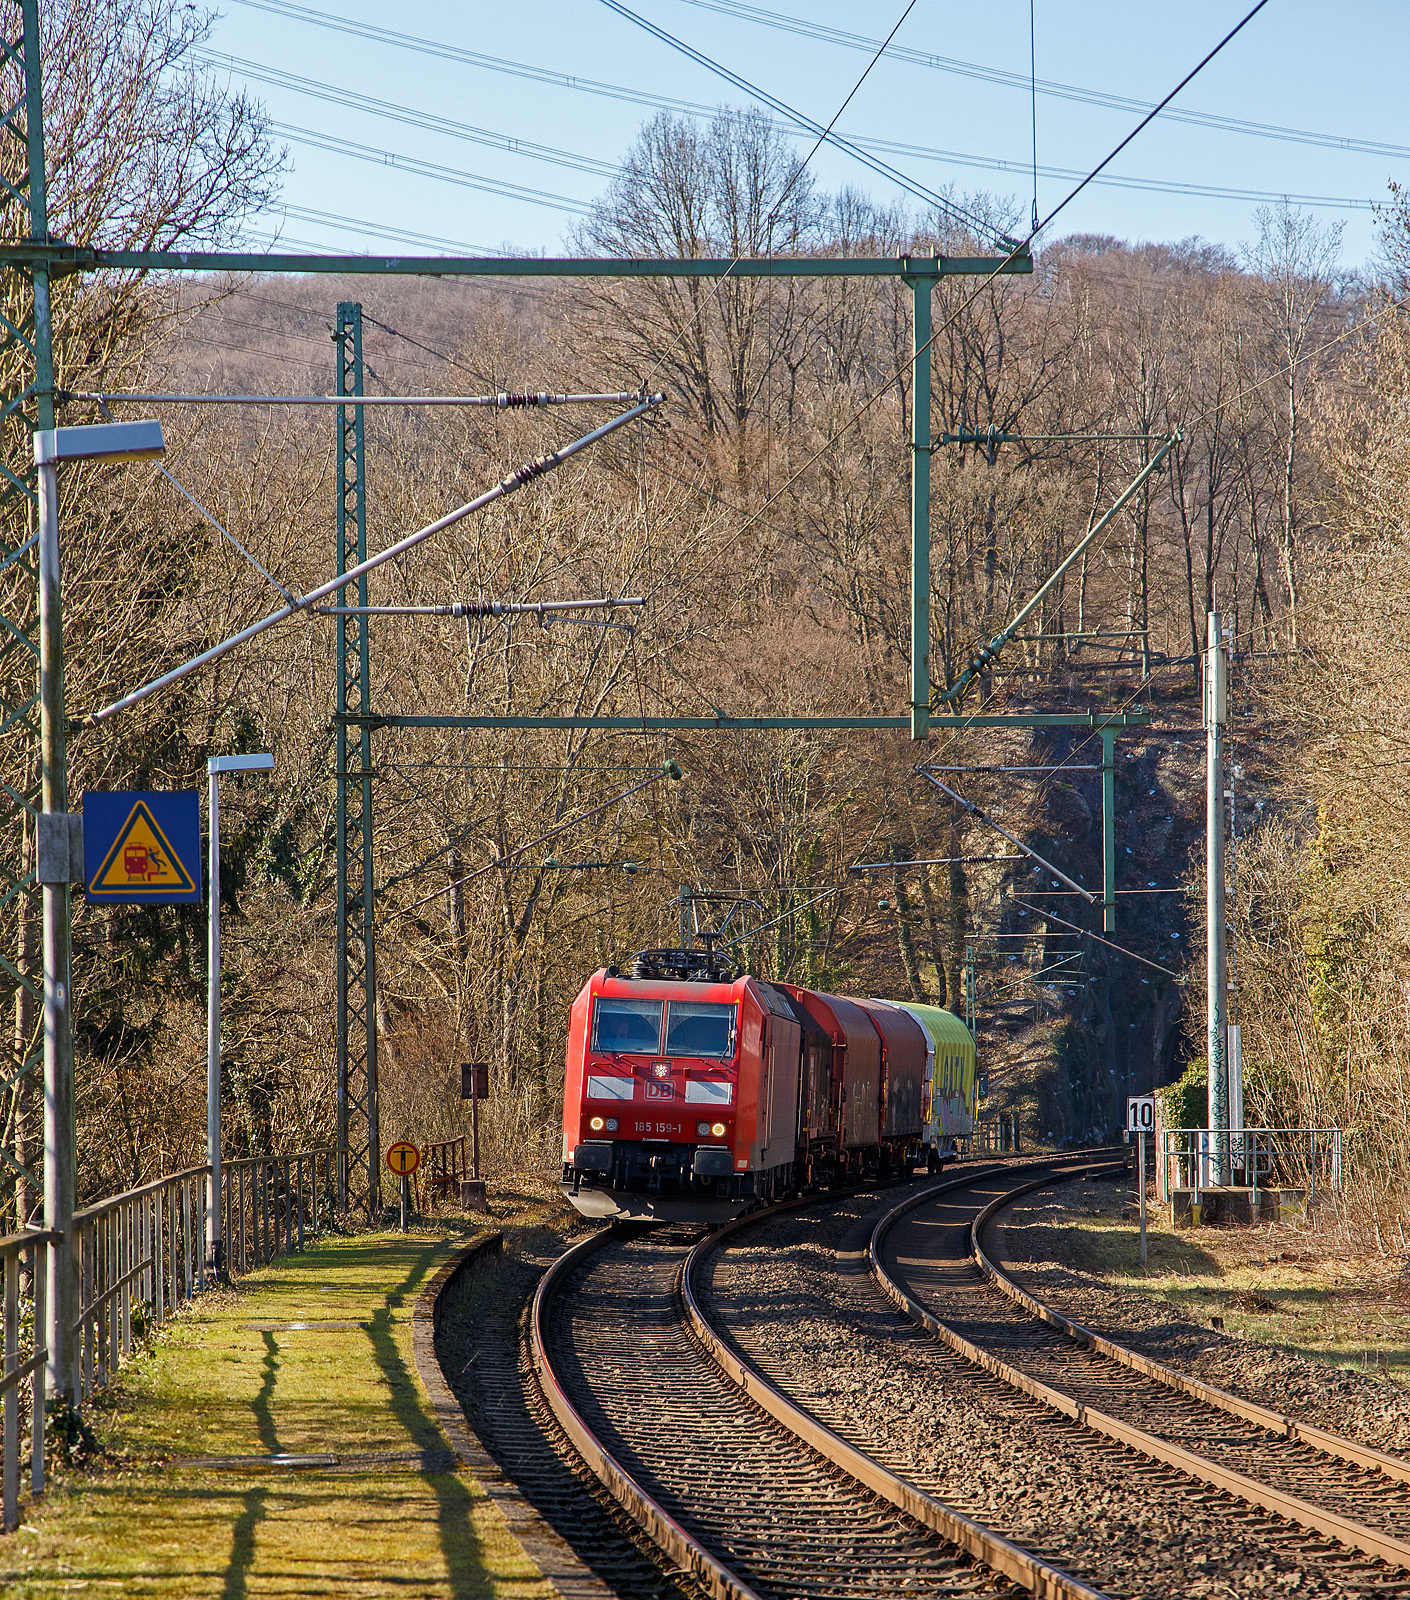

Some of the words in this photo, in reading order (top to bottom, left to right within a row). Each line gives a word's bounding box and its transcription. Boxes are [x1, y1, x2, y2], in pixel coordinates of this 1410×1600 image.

[647, 1082, 673, 1099] DB
[1130, 1102, 1152, 1127] 10
[634, 1121, 652, 1131] 185
[655, 1122, 681, 1133] 159-1
